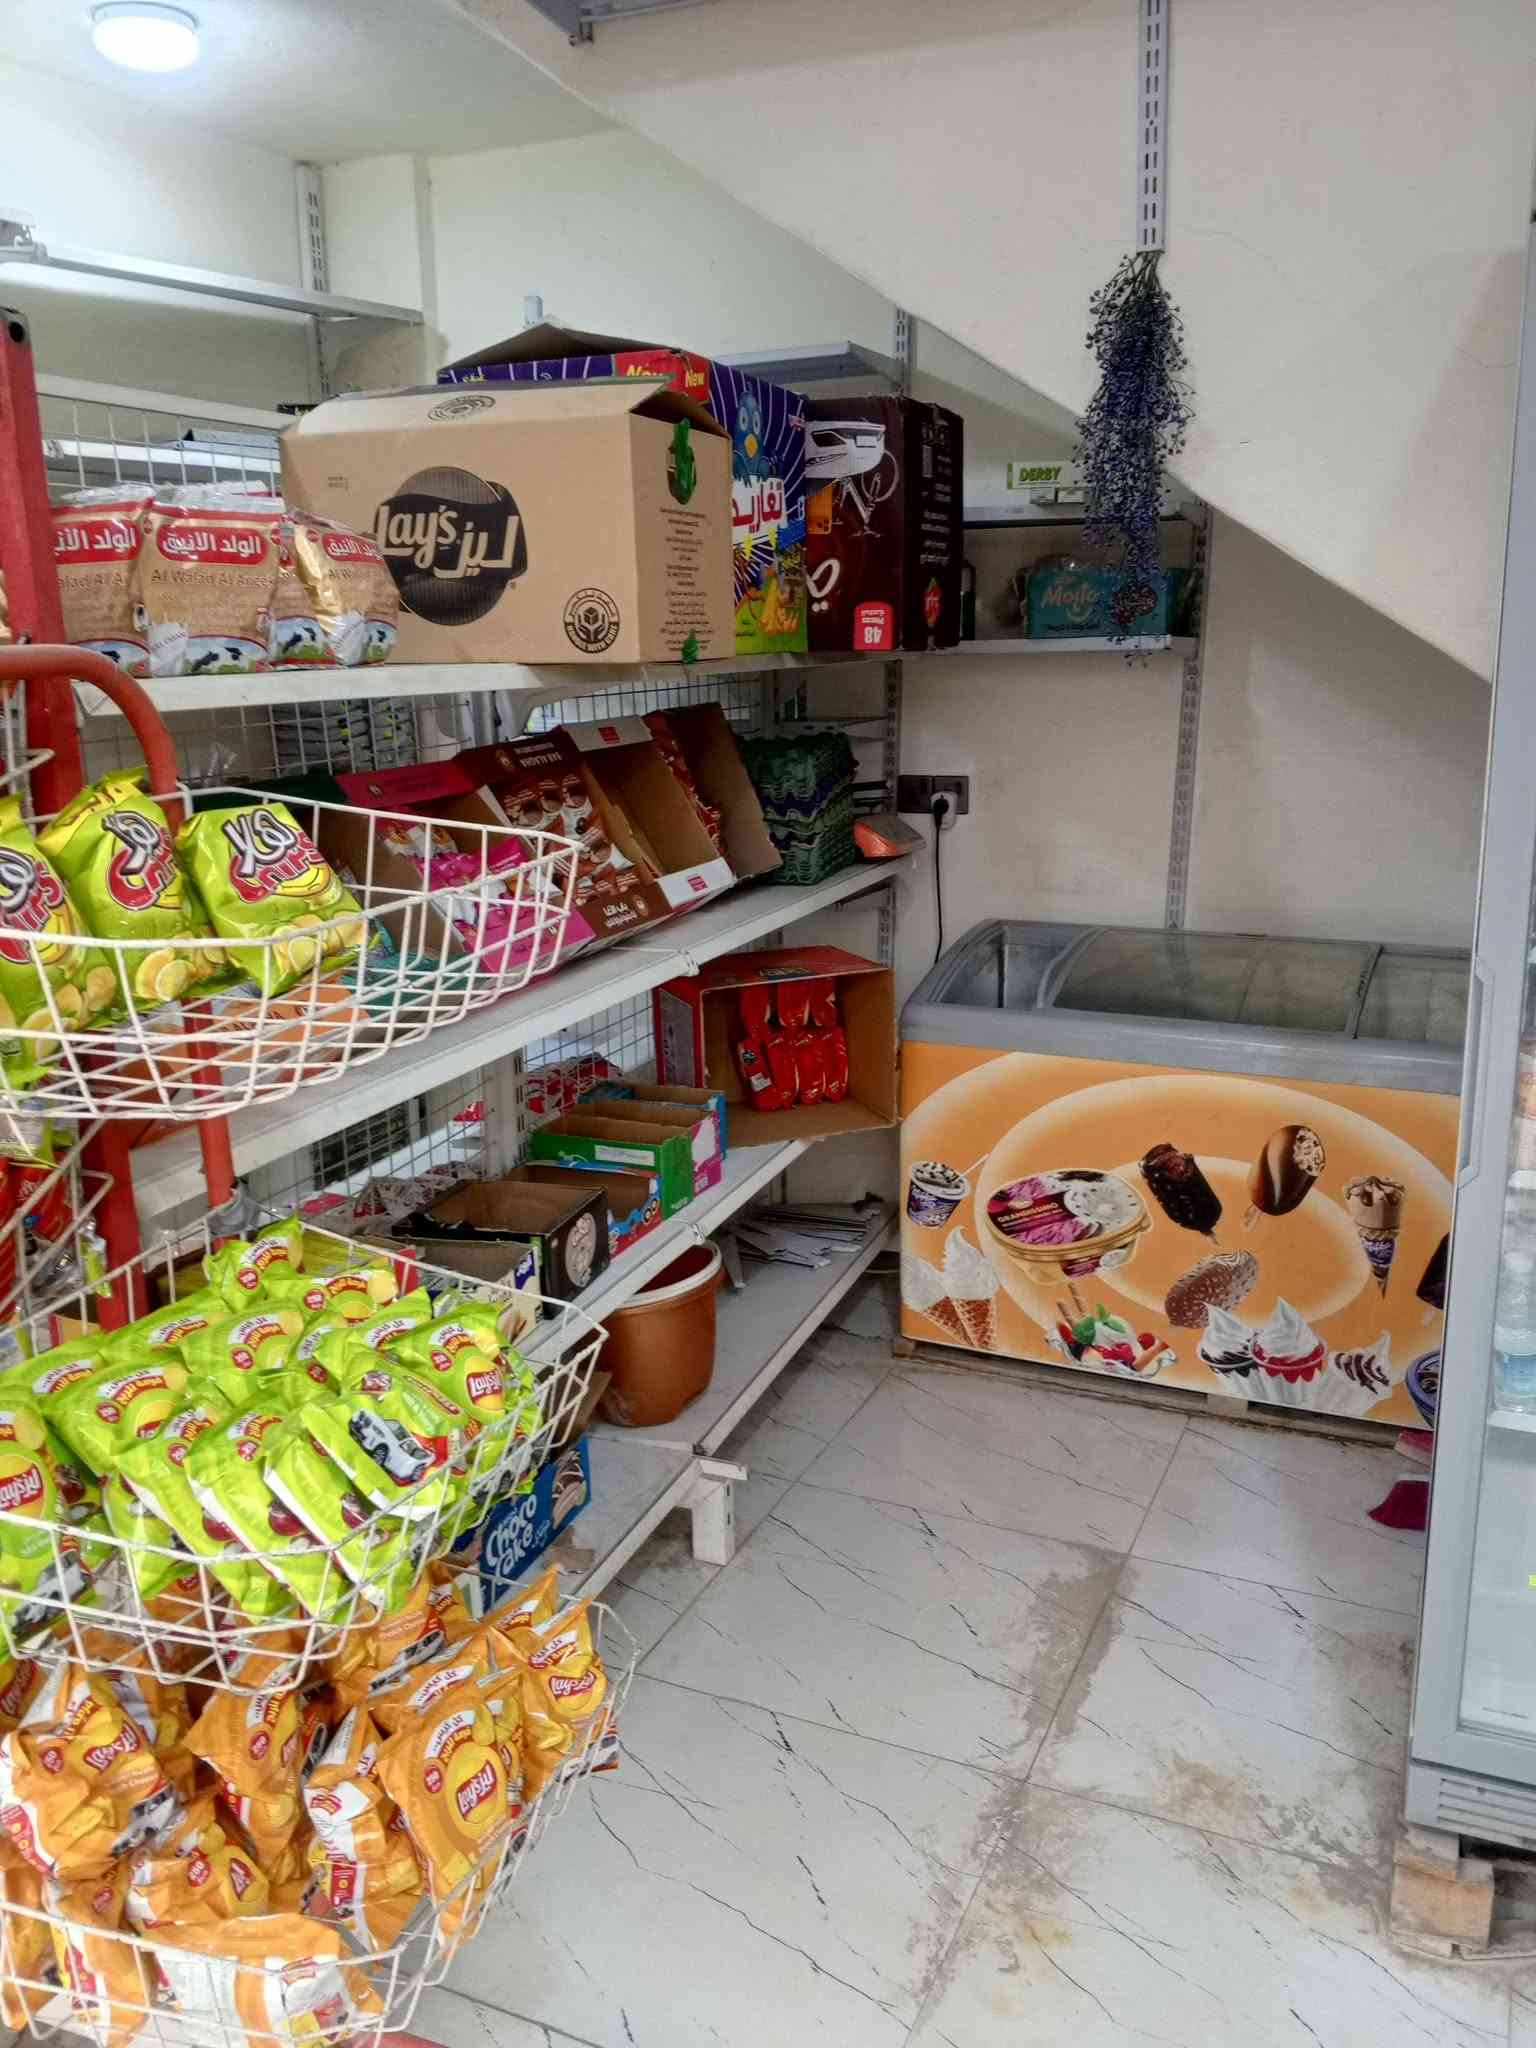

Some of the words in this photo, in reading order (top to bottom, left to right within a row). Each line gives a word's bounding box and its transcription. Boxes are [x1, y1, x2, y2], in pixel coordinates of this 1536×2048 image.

[685, 370, 705, 388] New
[1019, 466, 1062, 481] DERBY
[93, 526, 137, 553] الولد
[221, 534, 262, 558] الولد
[376, 504, 459, 570] Lay's
[433, 514, 520, 580] ليز
